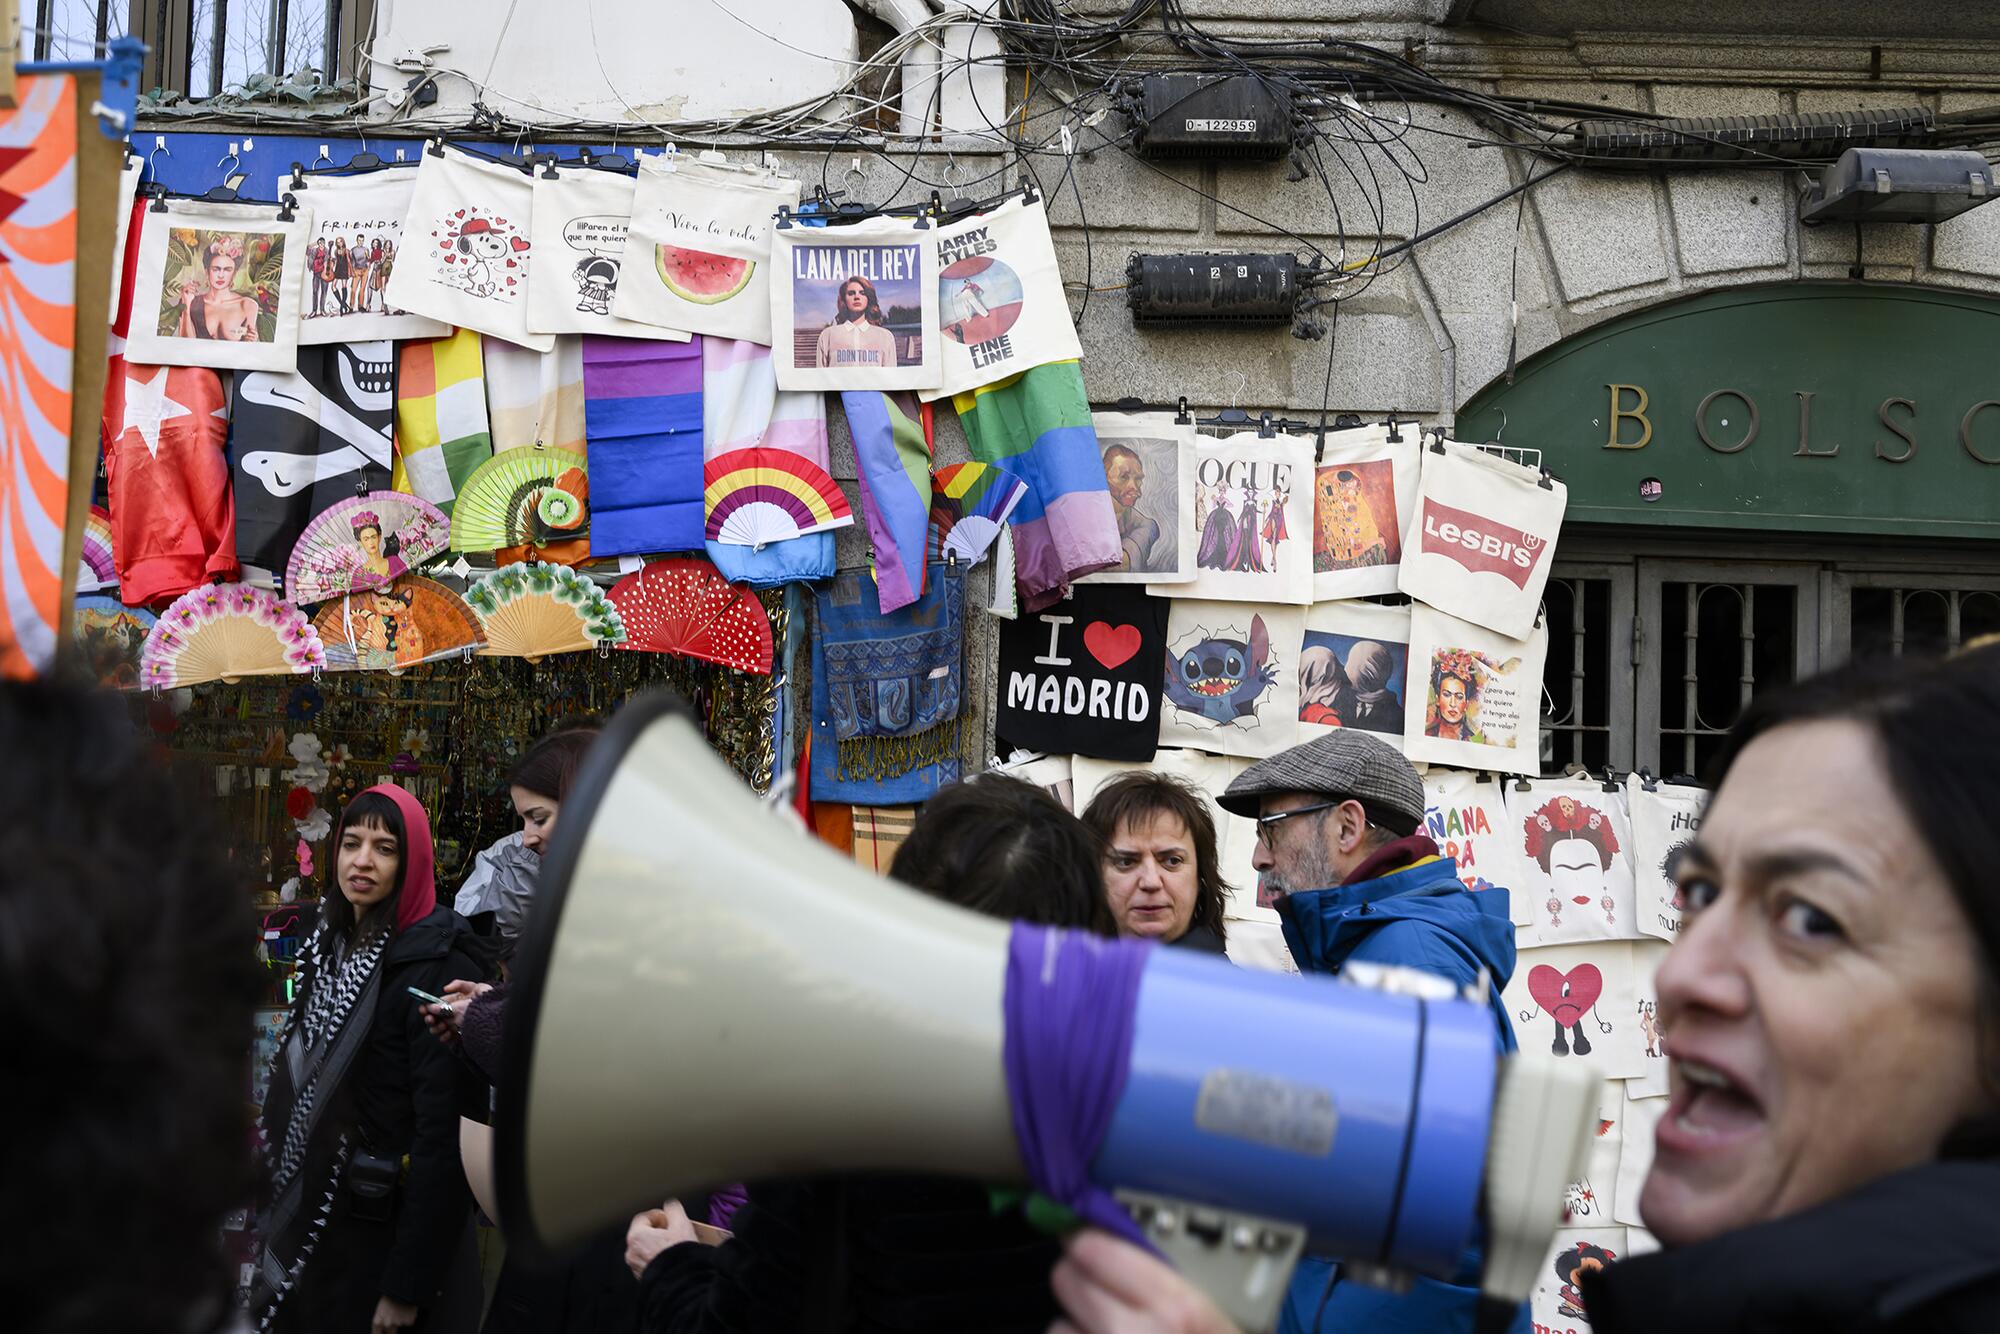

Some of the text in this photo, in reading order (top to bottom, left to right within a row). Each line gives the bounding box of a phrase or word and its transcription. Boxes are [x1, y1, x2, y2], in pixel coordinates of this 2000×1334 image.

[1186, 120, 1257, 132] 0-122959
[567, 234, 582, 242] que
[611, 224, 619, 232] el
[665, 212, 760, 242] Viva la vida
[796, 248, 916, 280] LANA DEL REY
[836, 350, 879, 363] BORN TO DIE
[969, 334, 1011, 357] FINE
[972, 346, 1014, 369] LINE
[1195, 457, 1293, 494] OGUE
[1034, 614, 1075, 666] I
[1007, 670, 1150, 723] MADRID
[1481, 720, 1497, 728] para
[1489, 710, 1507, 718] tengo
[1415, 805, 1492, 840] AÑANA
